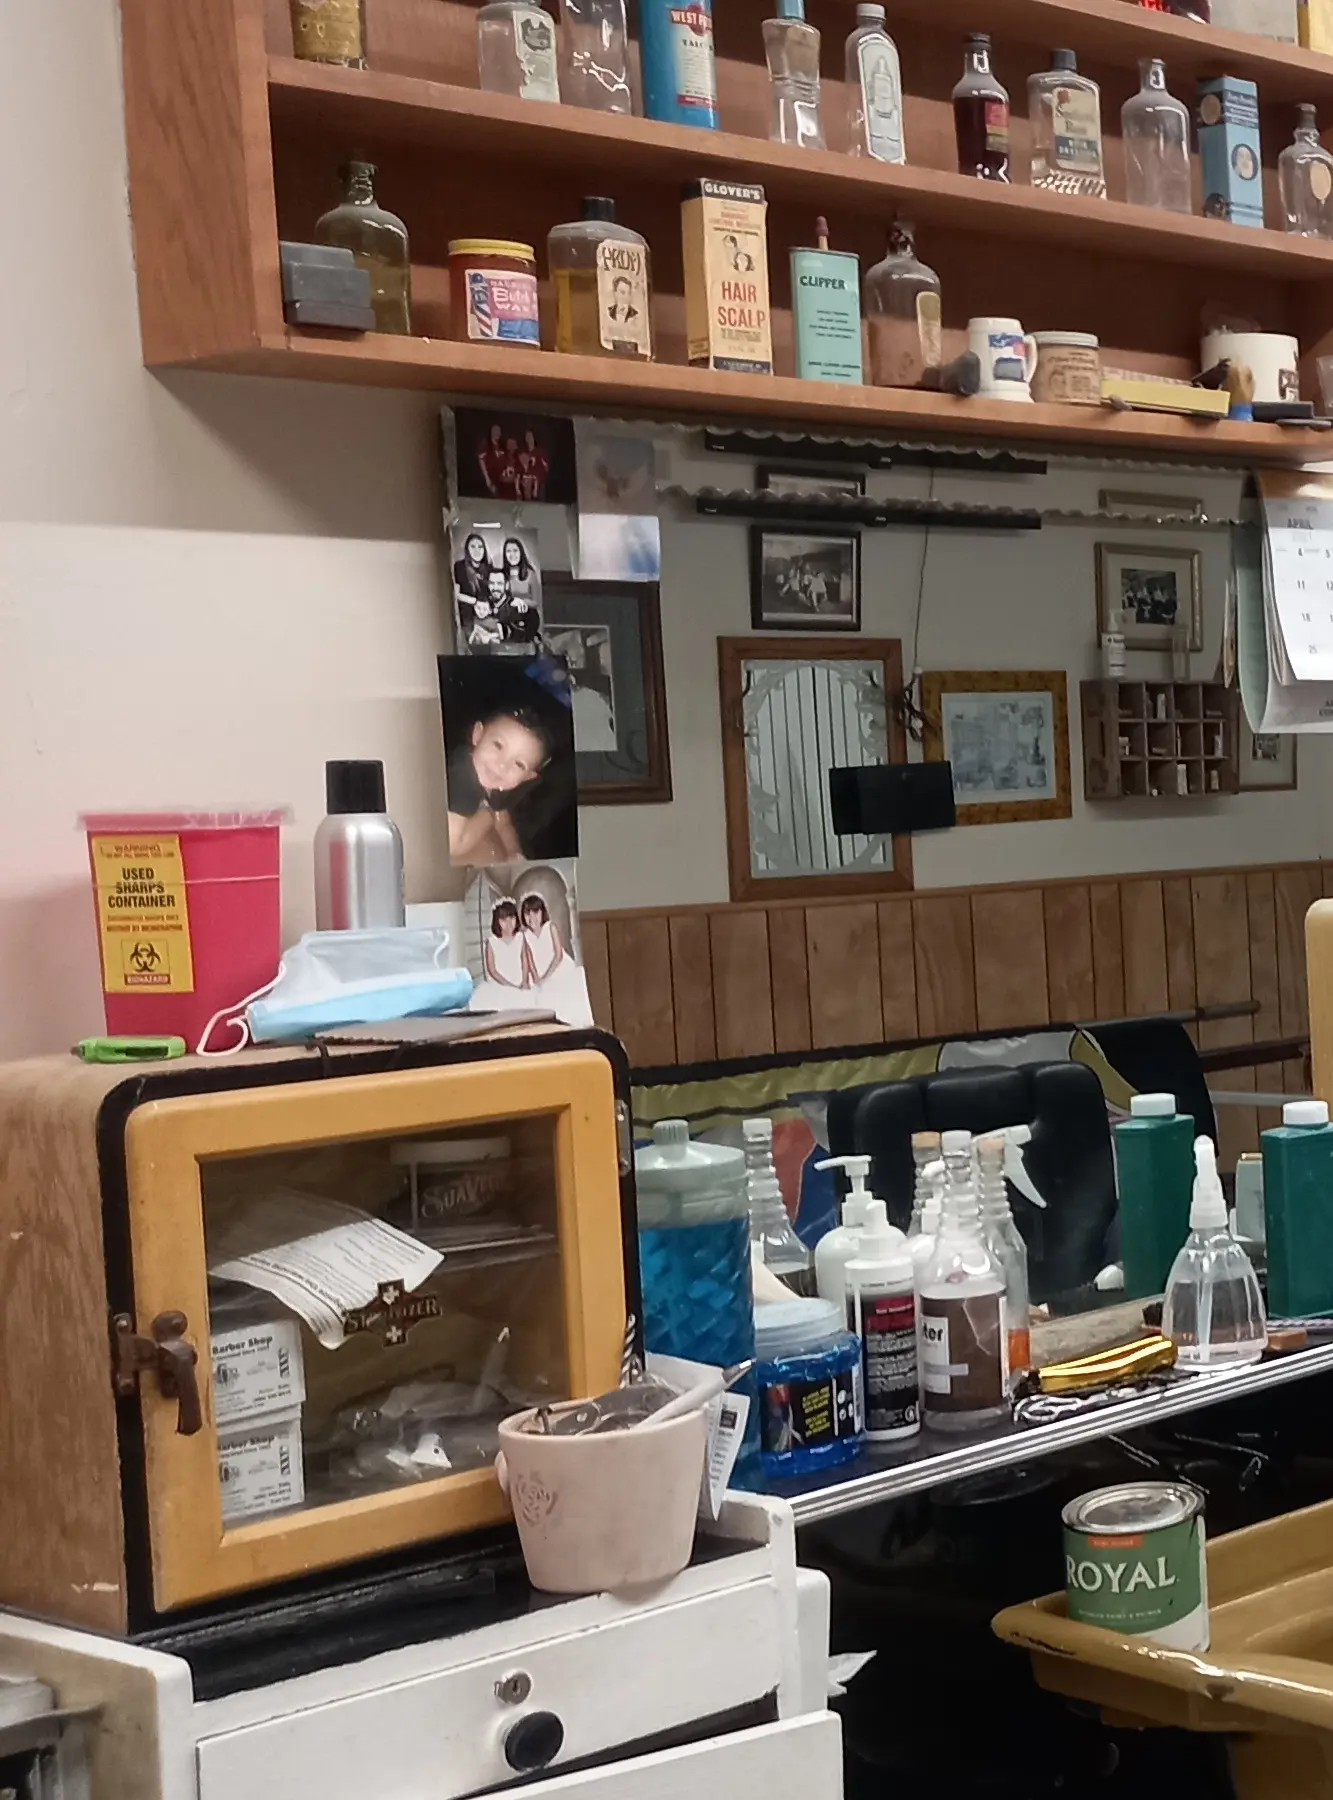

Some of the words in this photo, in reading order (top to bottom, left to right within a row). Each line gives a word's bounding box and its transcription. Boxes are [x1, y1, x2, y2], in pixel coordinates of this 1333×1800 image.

[671, 10, 697, 25] WEST
[705, 183, 761, 200] GLOVER'S
[800, 276, 846, 290] CLIPPER
[721, 281, 757, 302] HAIR
[717, 306, 766, 328] SCALP
[1297, 580, 1305, 590] 11
[1326, 581, 1333, 591] 12
[122, 867, 154, 880] USED
[115, 882, 165, 894] SHARPS
[107, 895, 176, 908] CONTAINER
[248, 1336, 273, 1349] Shop
[1065, 1555, 1176, 1594] ROYAL
